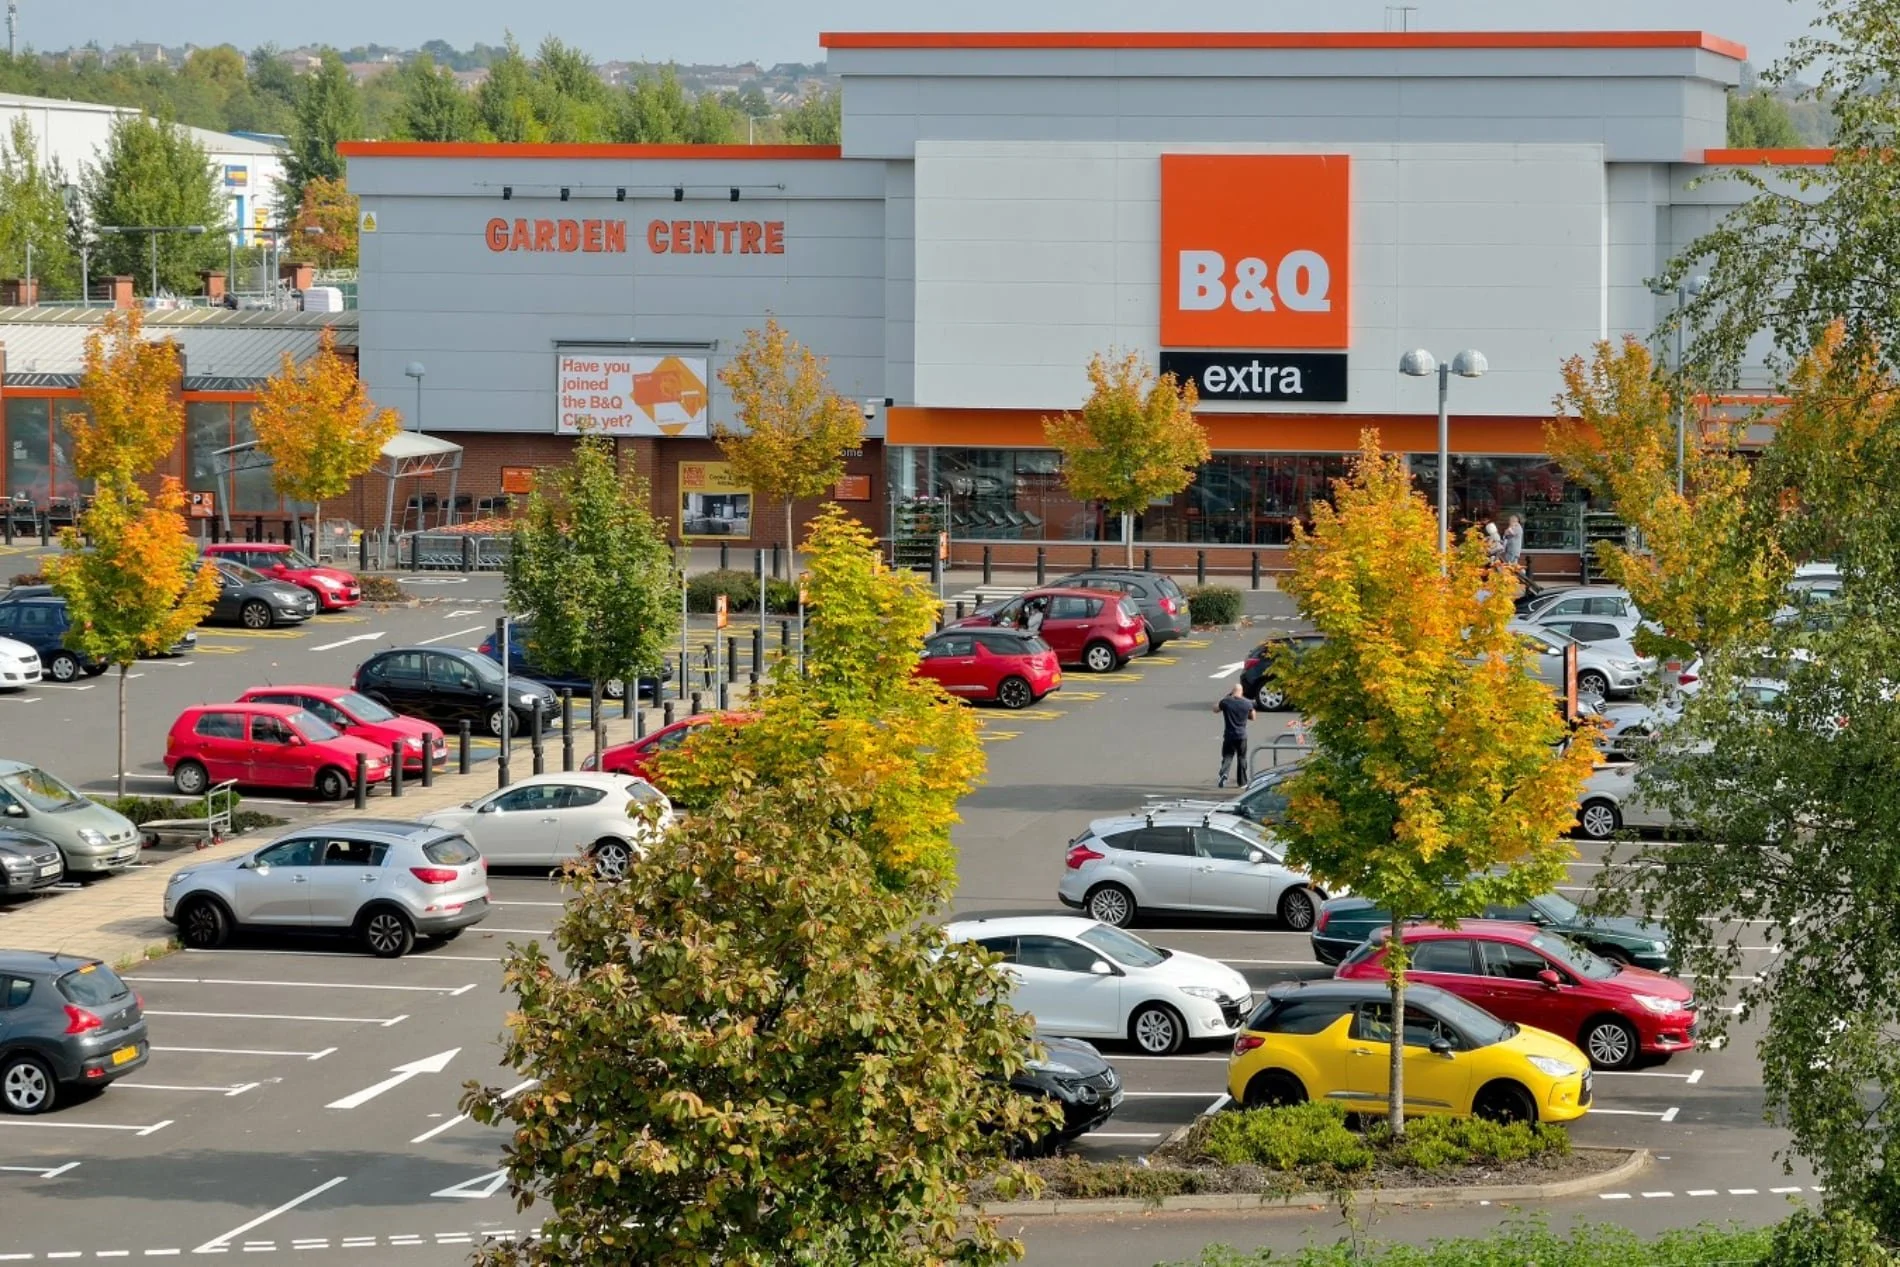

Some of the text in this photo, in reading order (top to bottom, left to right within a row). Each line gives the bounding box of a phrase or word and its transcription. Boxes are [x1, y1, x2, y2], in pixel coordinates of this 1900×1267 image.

[485, 217, 785, 255] GARDEN CENTRE
[1178, 249, 1331, 312] B&Q
[562, 359, 630, 376] Have you
[562, 378, 609, 393] joined
[1203, 360, 1303, 394] extra
[562, 395, 623, 409] the B&Q
[601, 414, 633, 430] yet?
